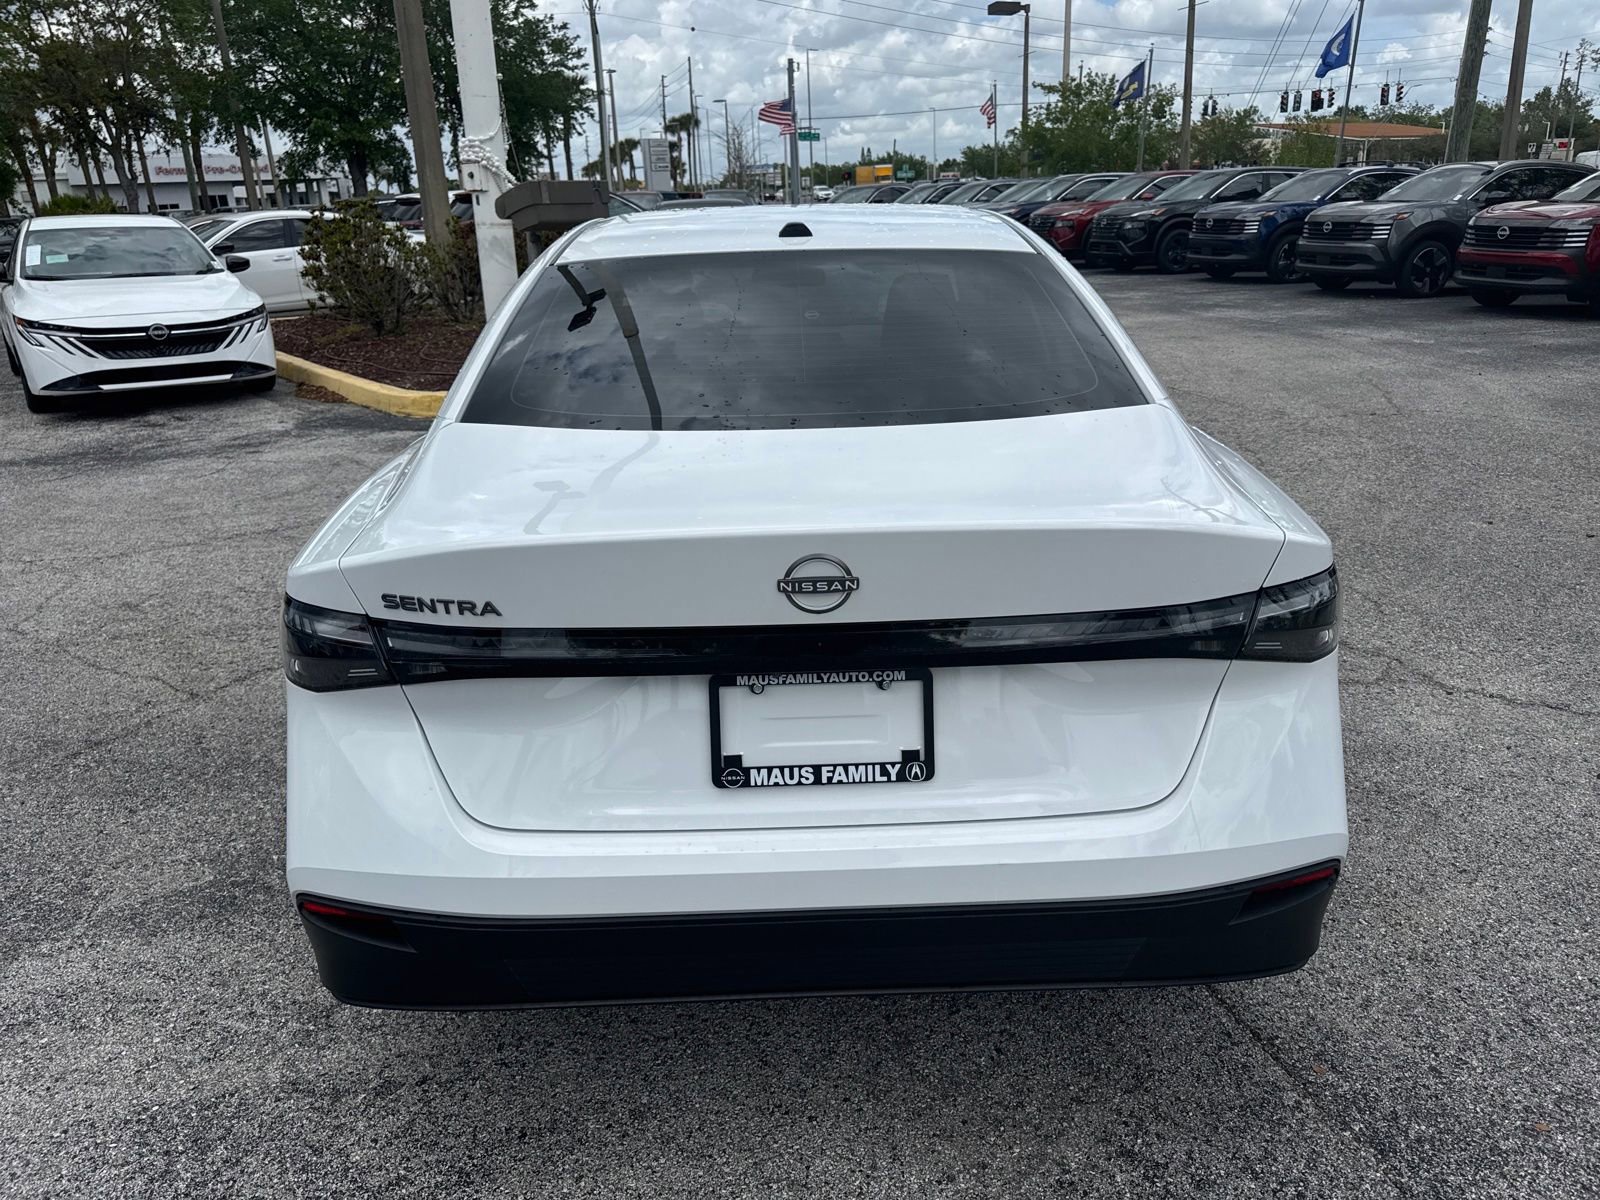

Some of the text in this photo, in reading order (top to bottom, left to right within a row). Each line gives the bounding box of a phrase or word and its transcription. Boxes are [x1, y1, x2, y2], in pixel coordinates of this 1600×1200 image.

[780, 580, 857, 592] NISSAN
[381, 593, 503, 616] SENTRA
[736, 671, 906, 686] MAUSFAMILYAUTO.COM
[750, 764, 902, 786] MAUS FAMILY
